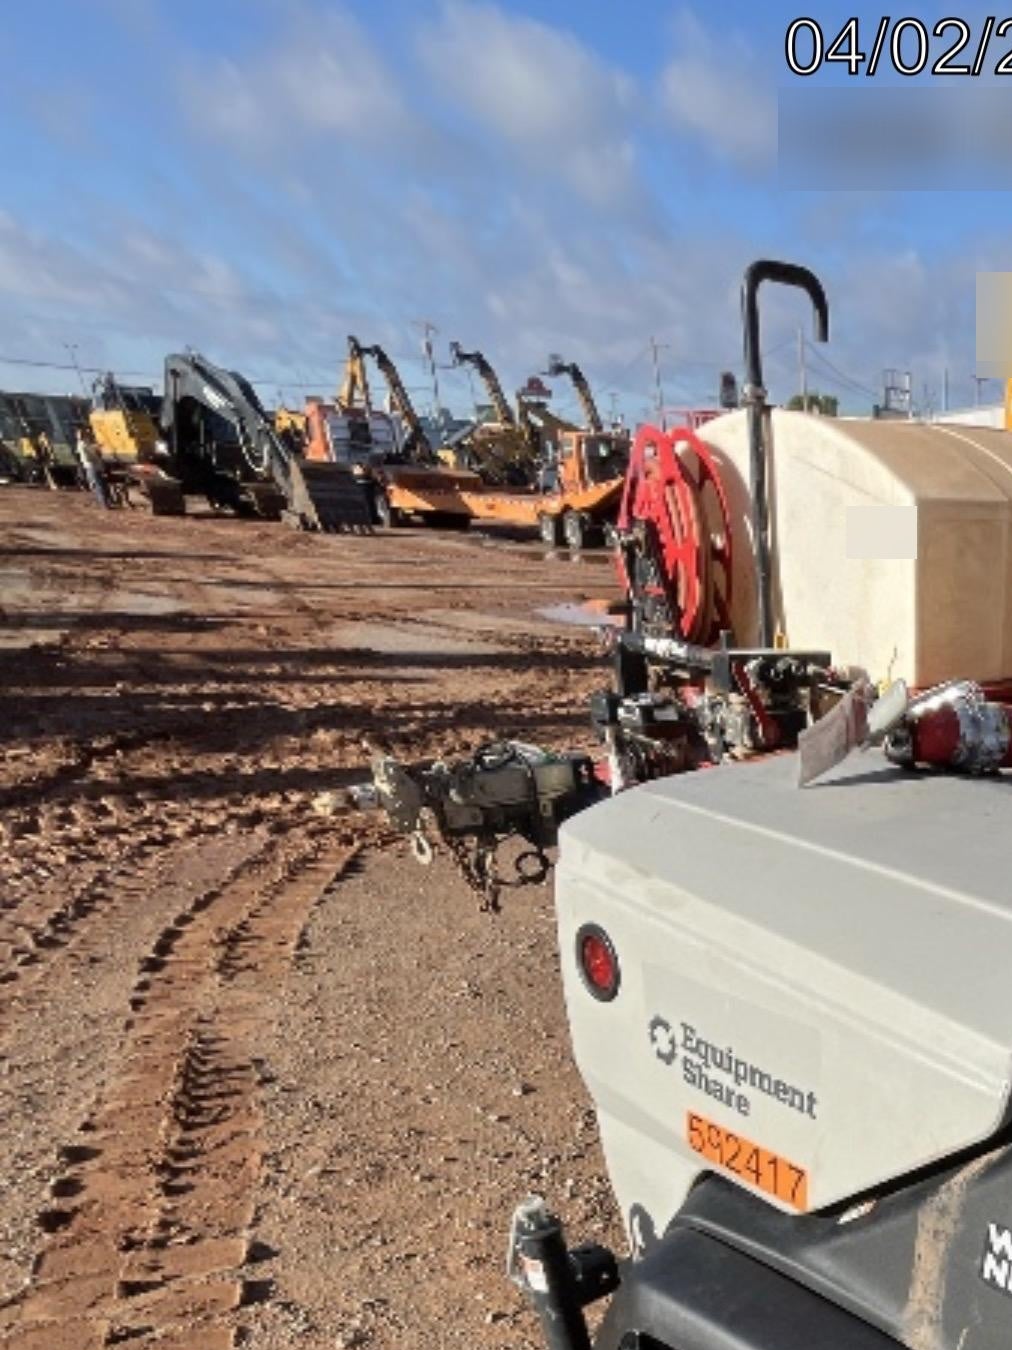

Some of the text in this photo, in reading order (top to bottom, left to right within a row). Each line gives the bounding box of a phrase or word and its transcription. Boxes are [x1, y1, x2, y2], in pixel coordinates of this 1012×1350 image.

[681, 1022, 818, 1119] Equipment
[682, 1056, 750, 1117] Share
[687, 1112, 806, 1201] 592417
